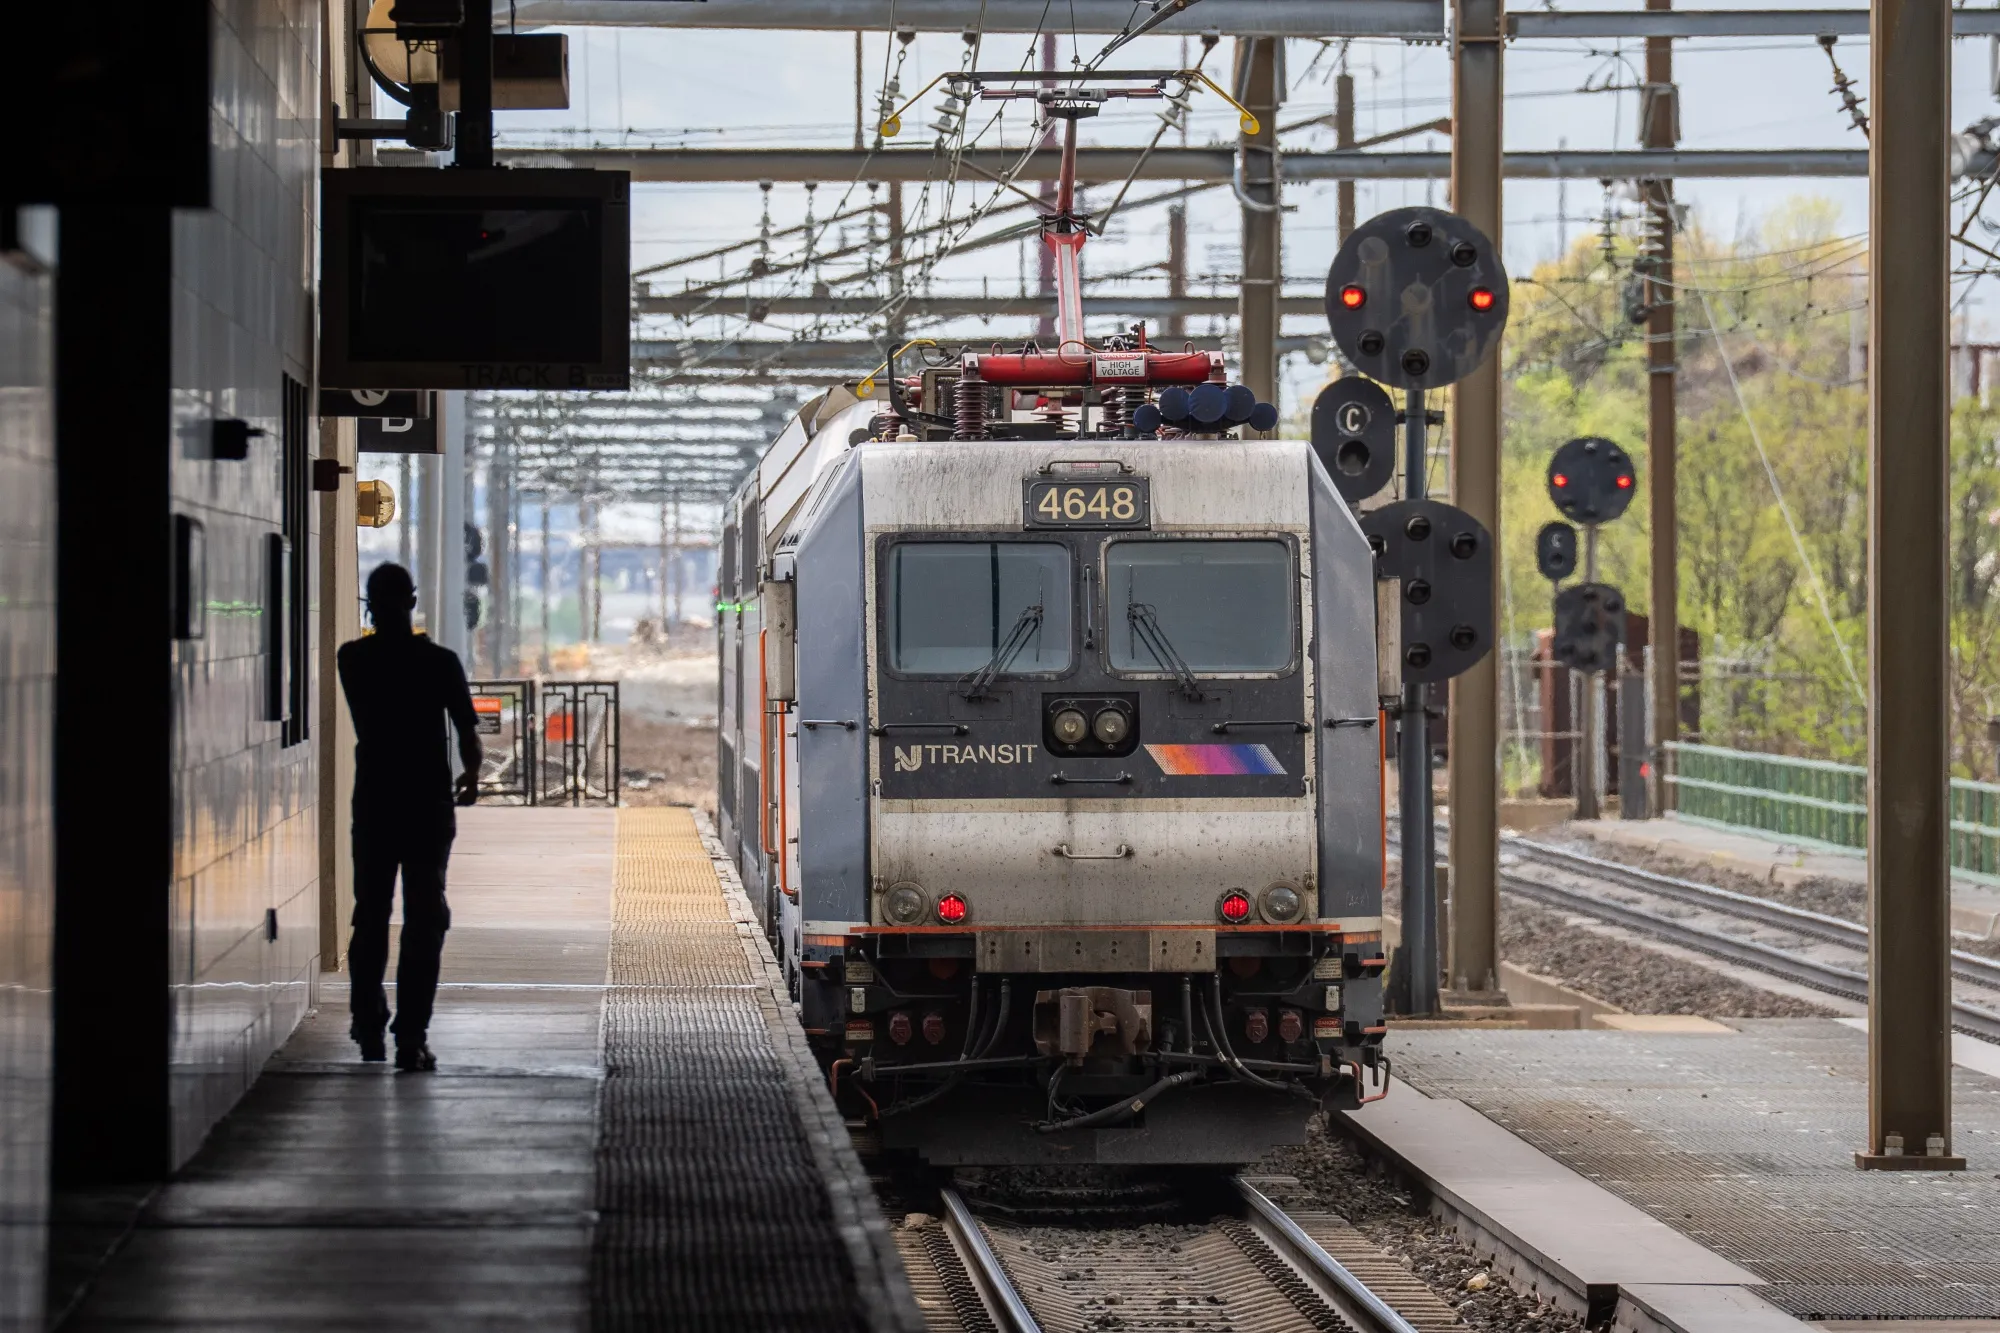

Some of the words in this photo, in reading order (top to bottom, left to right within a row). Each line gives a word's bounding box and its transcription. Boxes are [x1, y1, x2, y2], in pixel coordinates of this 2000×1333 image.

[460, 365, 552, 386] TRACK
[568, 365, 586, 386] B
[1101, 368, 1140, 376] VOLTAGE
[1109, 361, 1131, 369] HIGH
[1345, 407, 1361, 432] C
[1038, 487, 1135, 520] 4648
[893, 744, 923, 772] NJ
[924, 744, 1038, 764] TRANSIT
